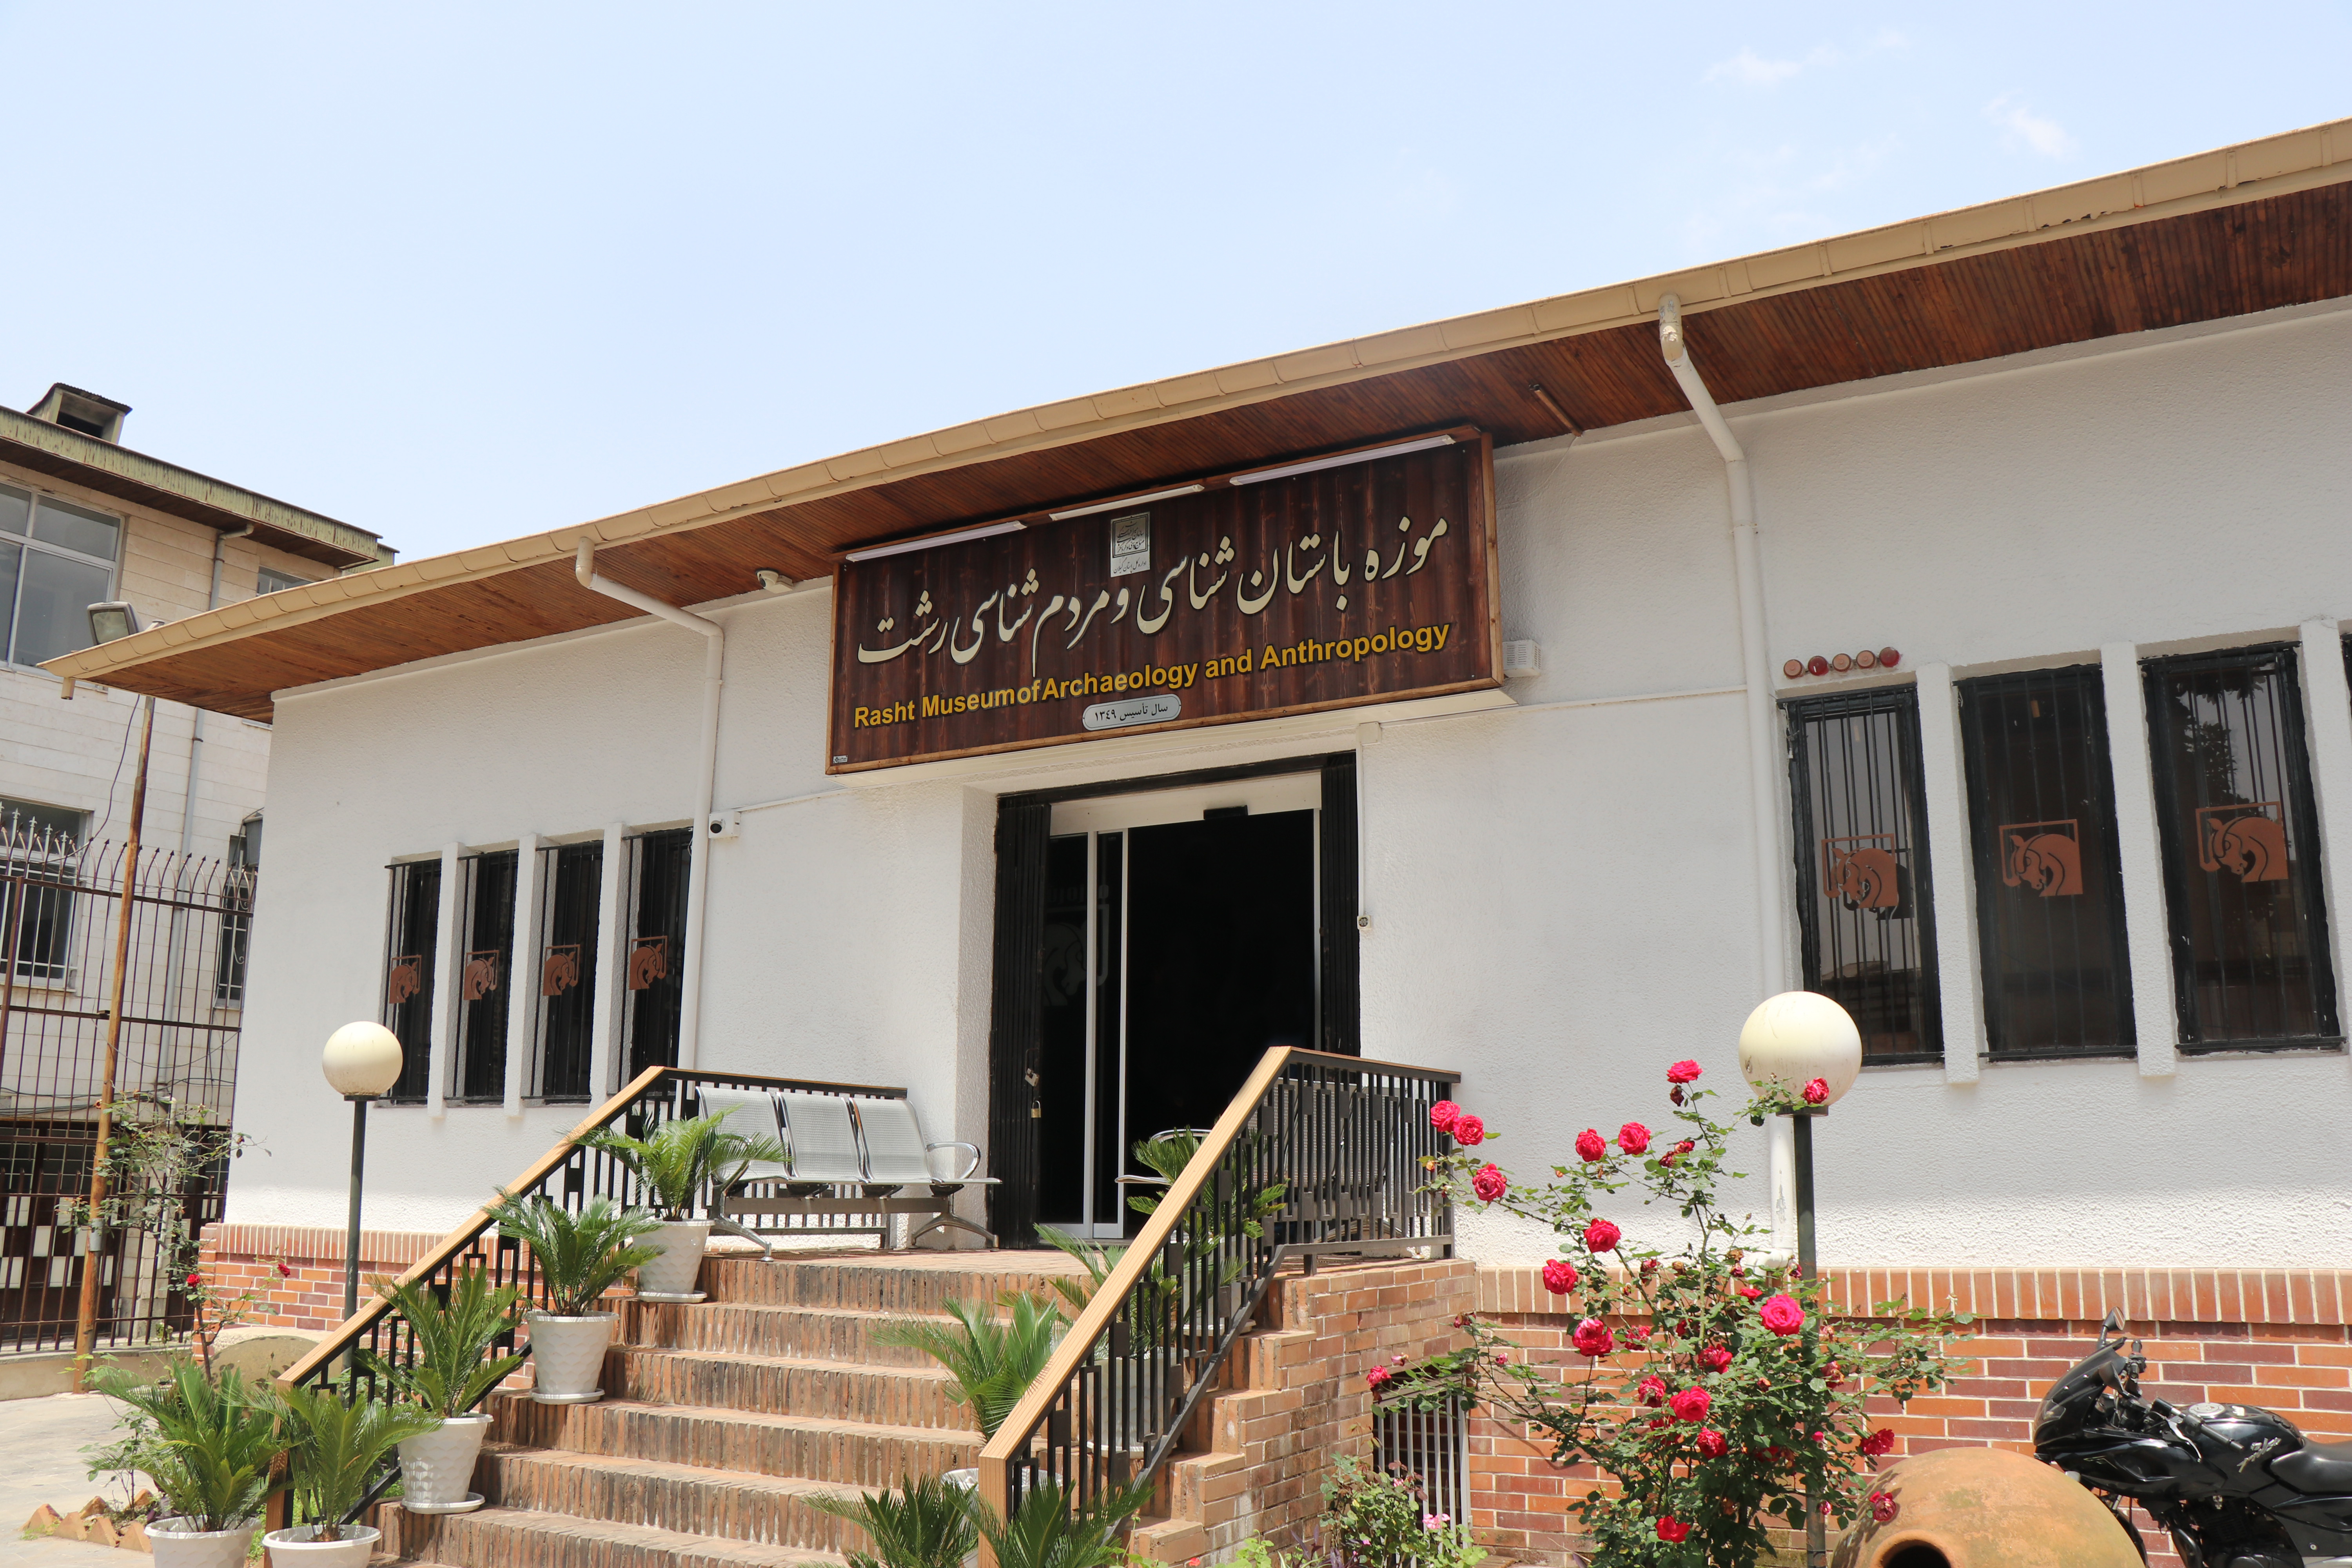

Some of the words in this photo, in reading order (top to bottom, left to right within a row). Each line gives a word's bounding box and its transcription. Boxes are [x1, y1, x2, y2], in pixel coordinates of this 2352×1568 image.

[1113, 557, 1128, 574] گیلان
[1123, 561, 1132, 572] استان
[1132, 557, 1140, 570] کل
[1237, 530, 1350, 614] باستان
[1365, 516, 1448, 581] موزه
[950, 568, 1040, 664] شناسی
[1111, 587, 1130, 624] و
[1136, 536, 1235, 634] شناسی
[858, 590, 948, 663] رشت
[1032, 590, 1111, 677] مردم
[854, 700, 915, 728] Rasht
[922, 688, 1014, 718] Museum
[1017, 679, 1041, 704] of
[1042, 662, 1198, 701] Archaeology
[1205, 648, 1252, 679] and
[1259, 624, 1450, 670] Anthropology
[1120, 702, 1148, 721] تأسیس
[1151, 703, 1168, 716] سال
